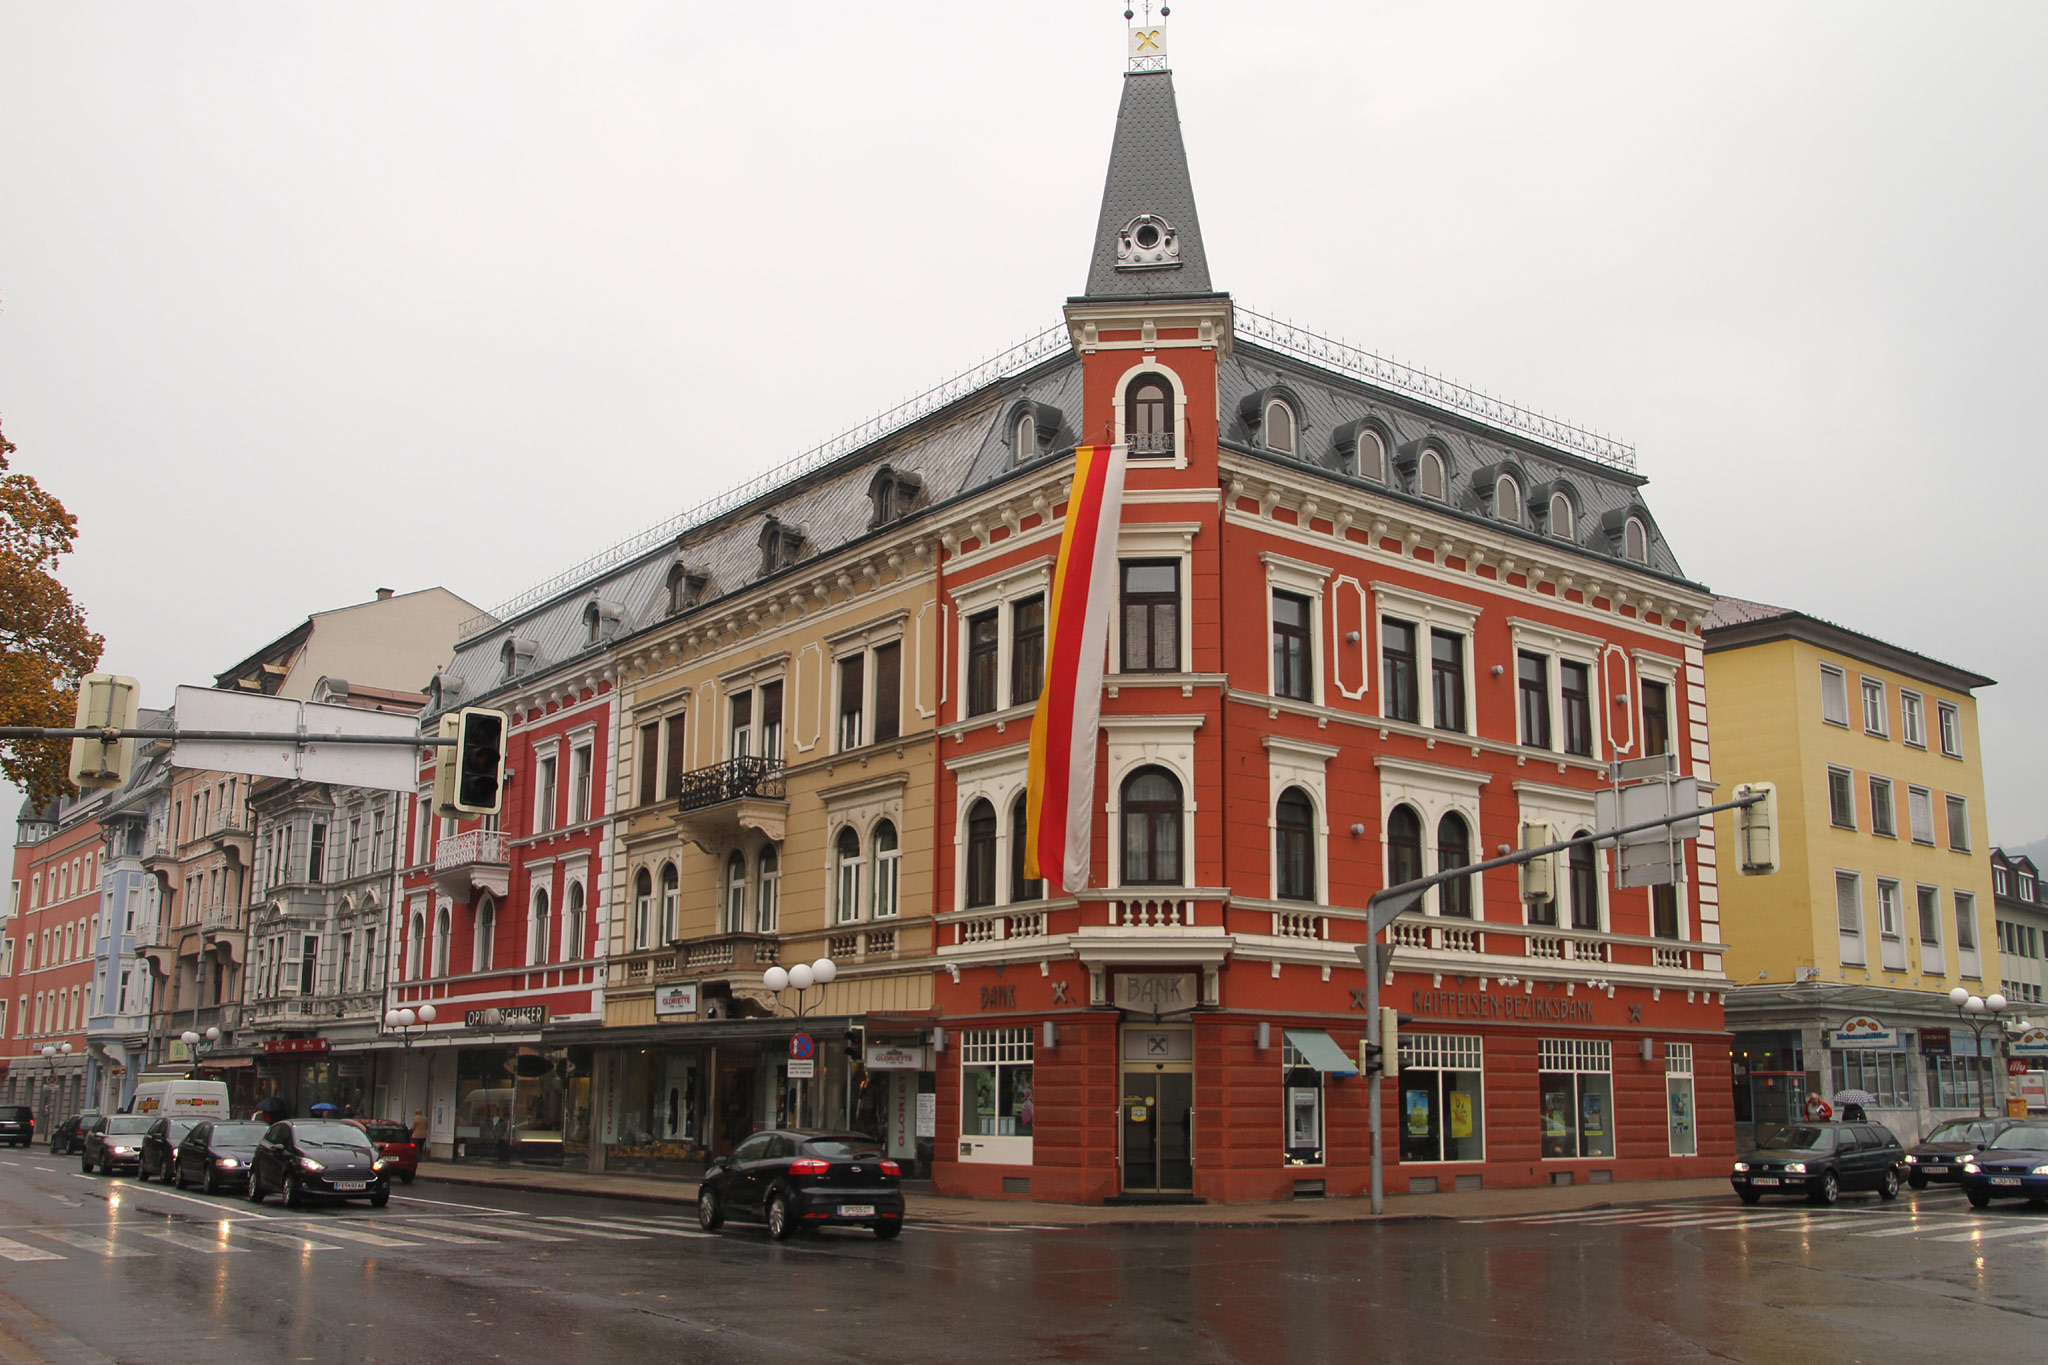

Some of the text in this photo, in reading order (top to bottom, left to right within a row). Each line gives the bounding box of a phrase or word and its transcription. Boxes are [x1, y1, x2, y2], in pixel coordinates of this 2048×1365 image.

[980, 984, 1016, 1010] BANK
[1127, 976, 1185, 1003] BANK
[663, 996, 691, 1006] GLORIETTE
[2009, 1060, 2026, 1073] illy
